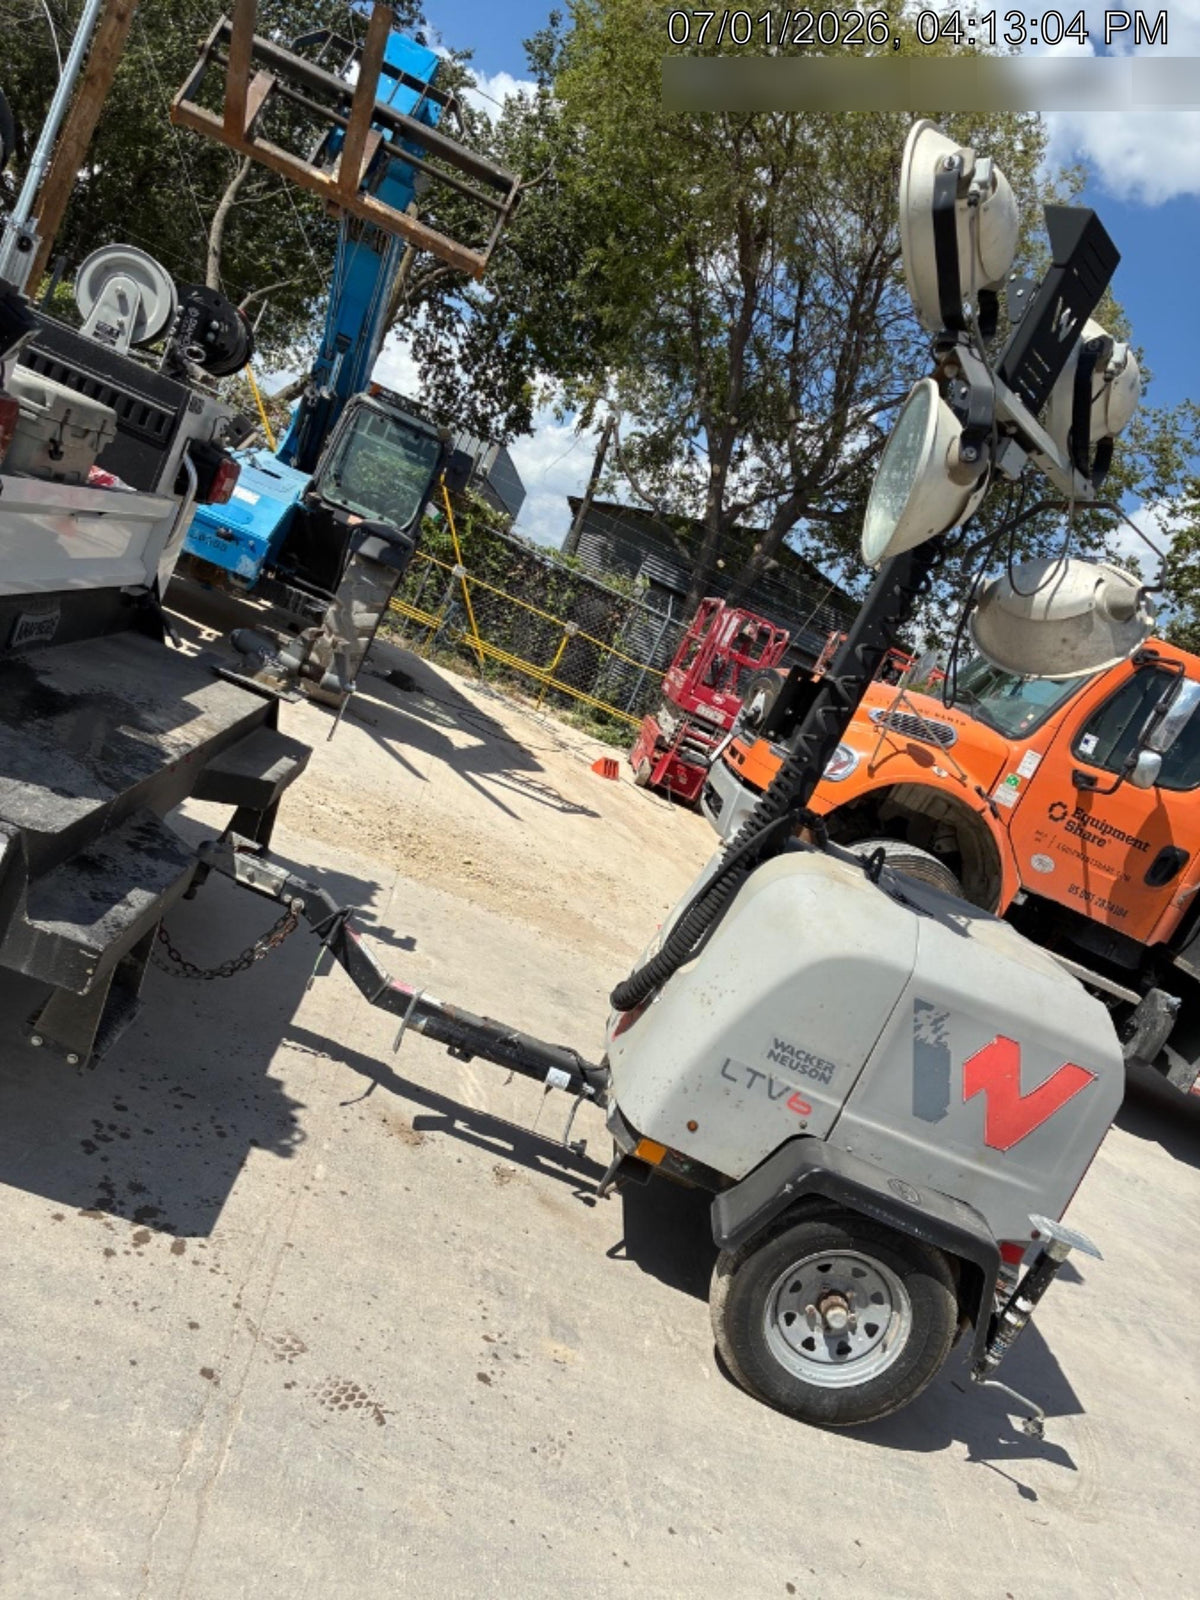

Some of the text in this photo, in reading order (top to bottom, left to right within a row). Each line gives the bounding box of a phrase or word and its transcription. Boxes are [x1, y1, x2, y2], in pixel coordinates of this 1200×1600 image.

[1064, 820, 1107, 848] Share
[1071, 806, 1151, 853] Equipment
[766, 1049, 833, 1085] NEUSON
[773, 1037, 836, 1075] WACKER
[720, 1057, 812, 1116] LTV6
